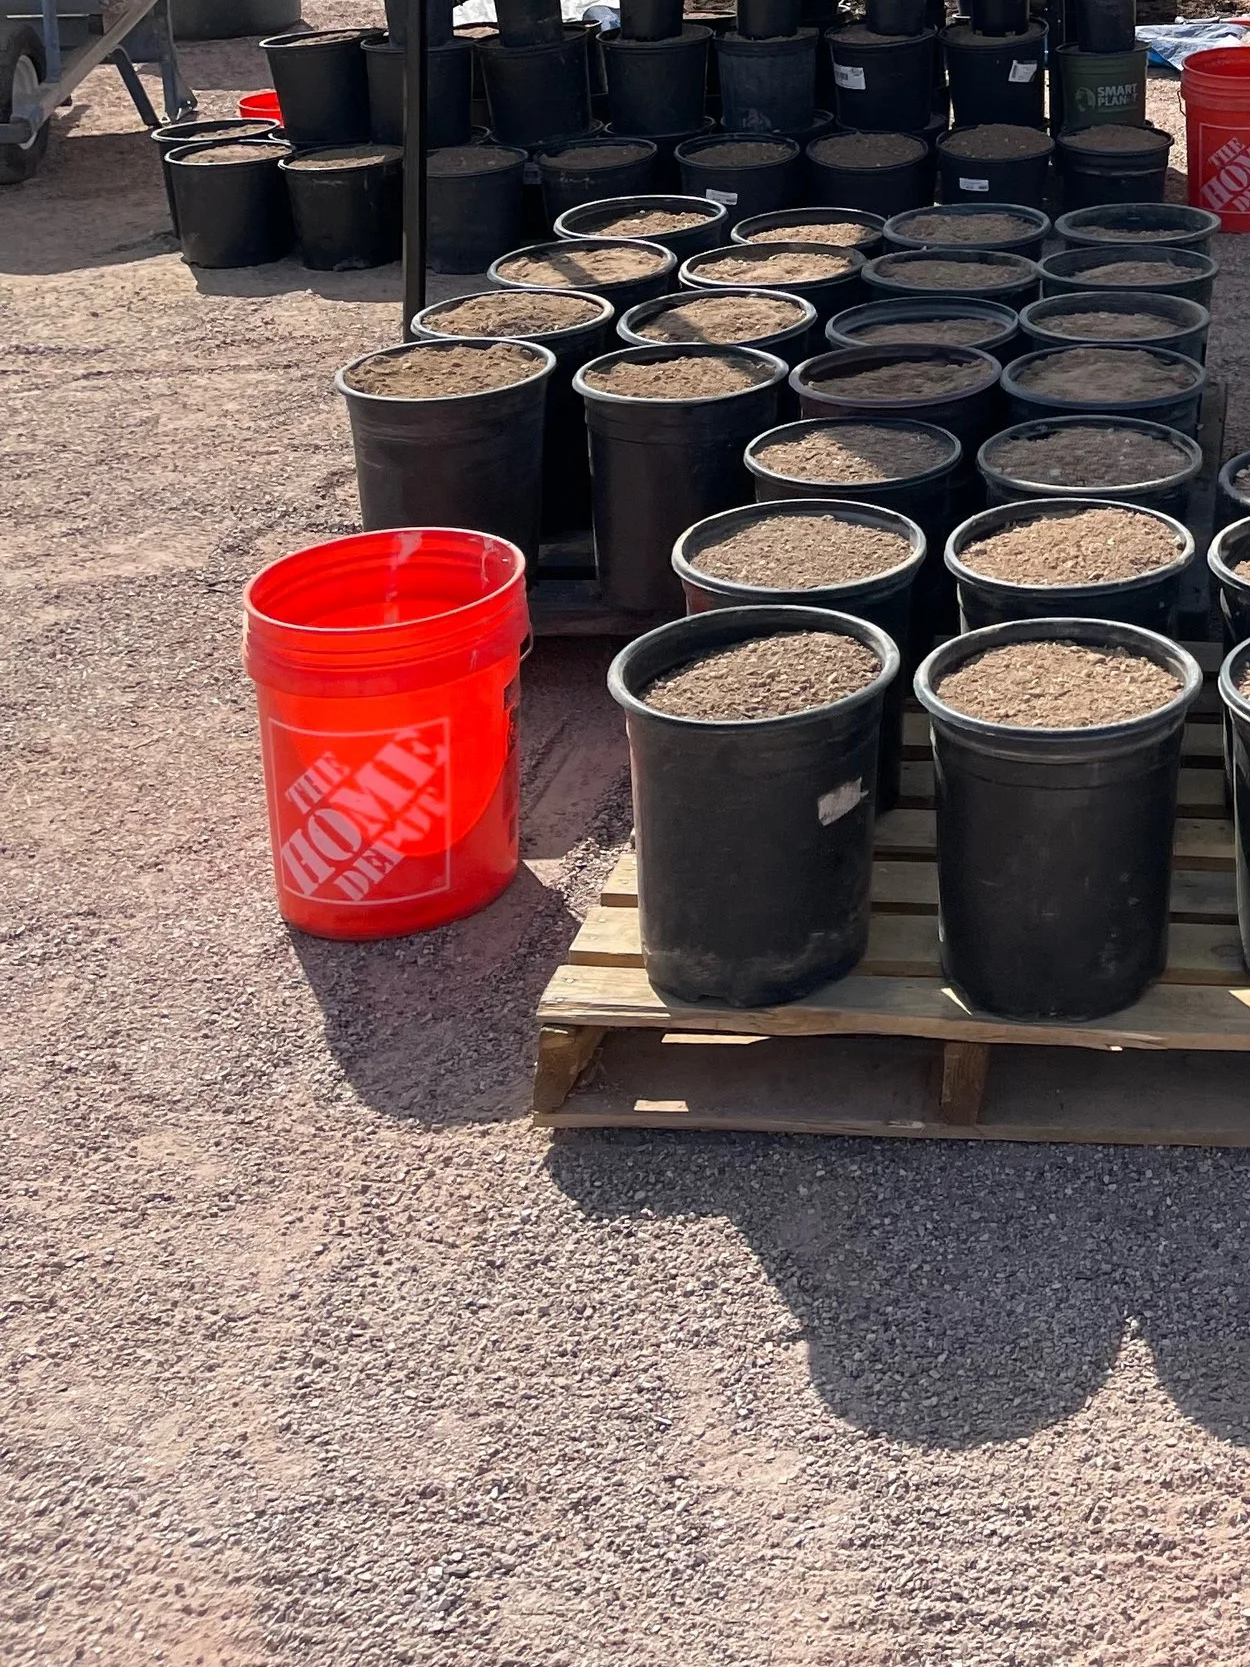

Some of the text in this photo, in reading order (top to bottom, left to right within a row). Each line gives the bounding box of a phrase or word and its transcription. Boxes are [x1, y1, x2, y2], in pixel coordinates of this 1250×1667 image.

[1097, 83, 1138, 97] SMART
[1208, 136, 1246, 168] THE
[281, 728, 446, 897] HOME
[284, 750, 352, 815] THE
[333, 784, 447, 902] DEPOT
